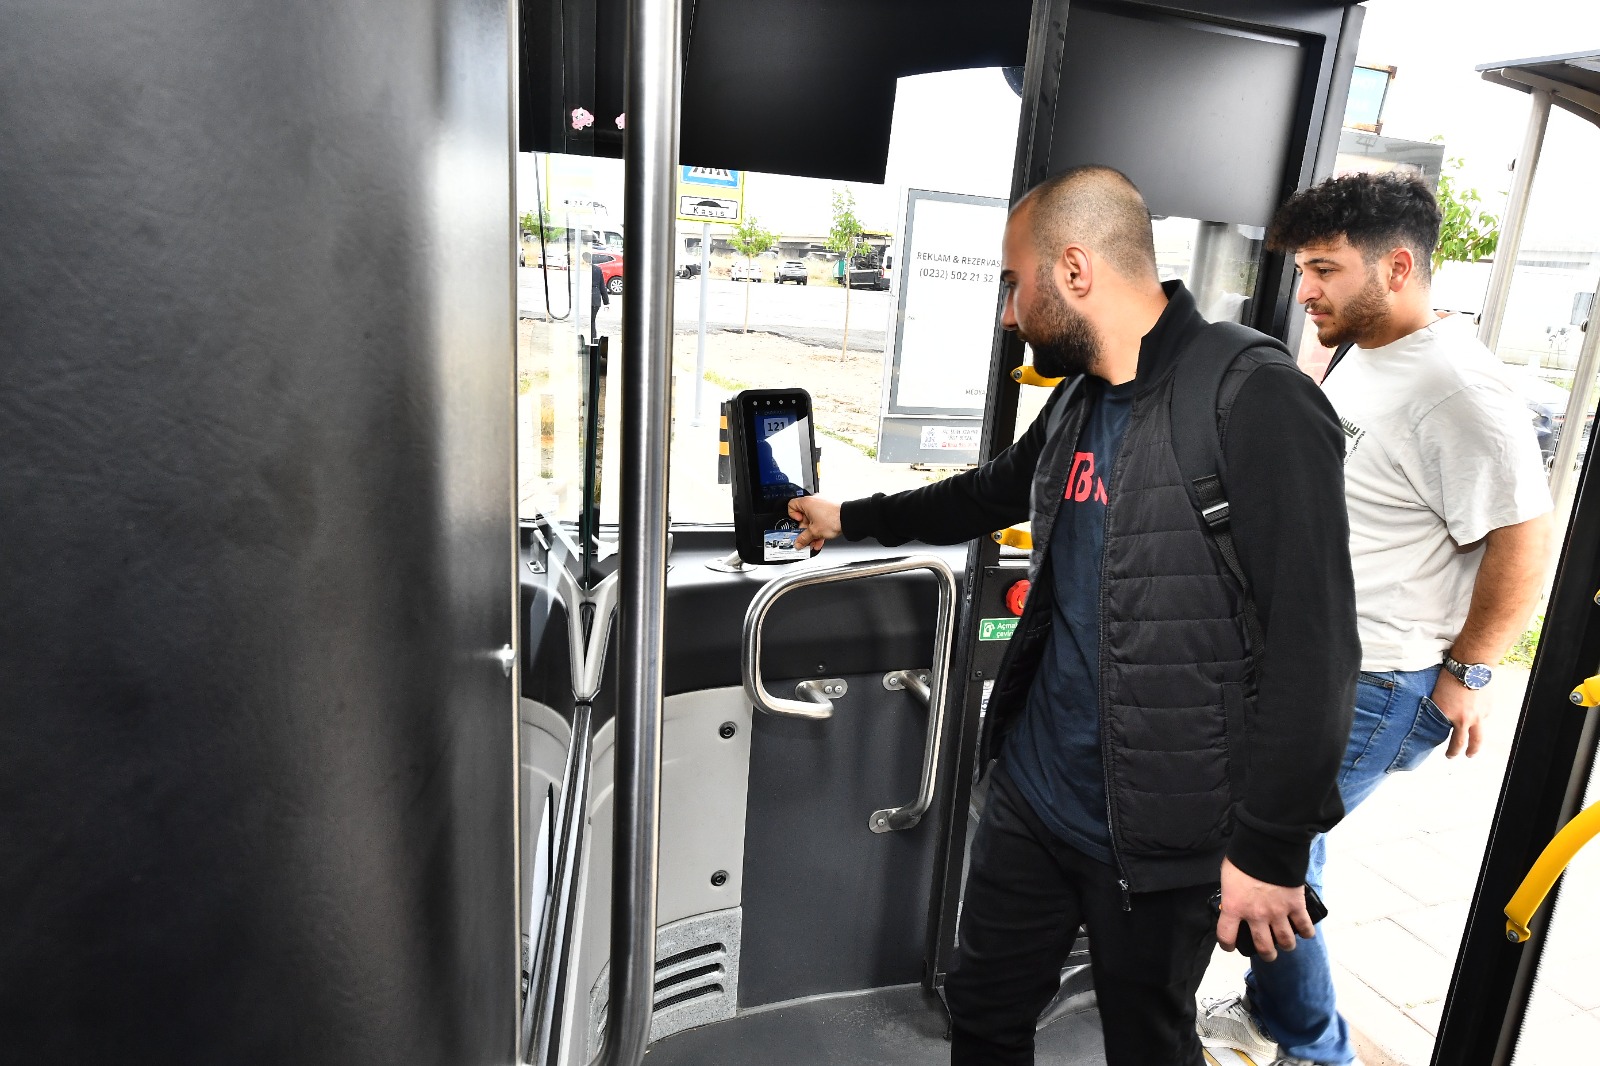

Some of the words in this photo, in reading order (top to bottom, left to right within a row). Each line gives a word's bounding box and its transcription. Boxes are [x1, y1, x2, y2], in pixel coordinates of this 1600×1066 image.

[917, 251, 951, 263] REKLAM
[953, 255, 960, 264] &
[919, 268, 948, 280] (0232)
[951, 270, 968, 281] 502
[969, 272, 980, 282] 21
[983, 274, 994, 283] 32
[767, 421, 785, 432] 121
